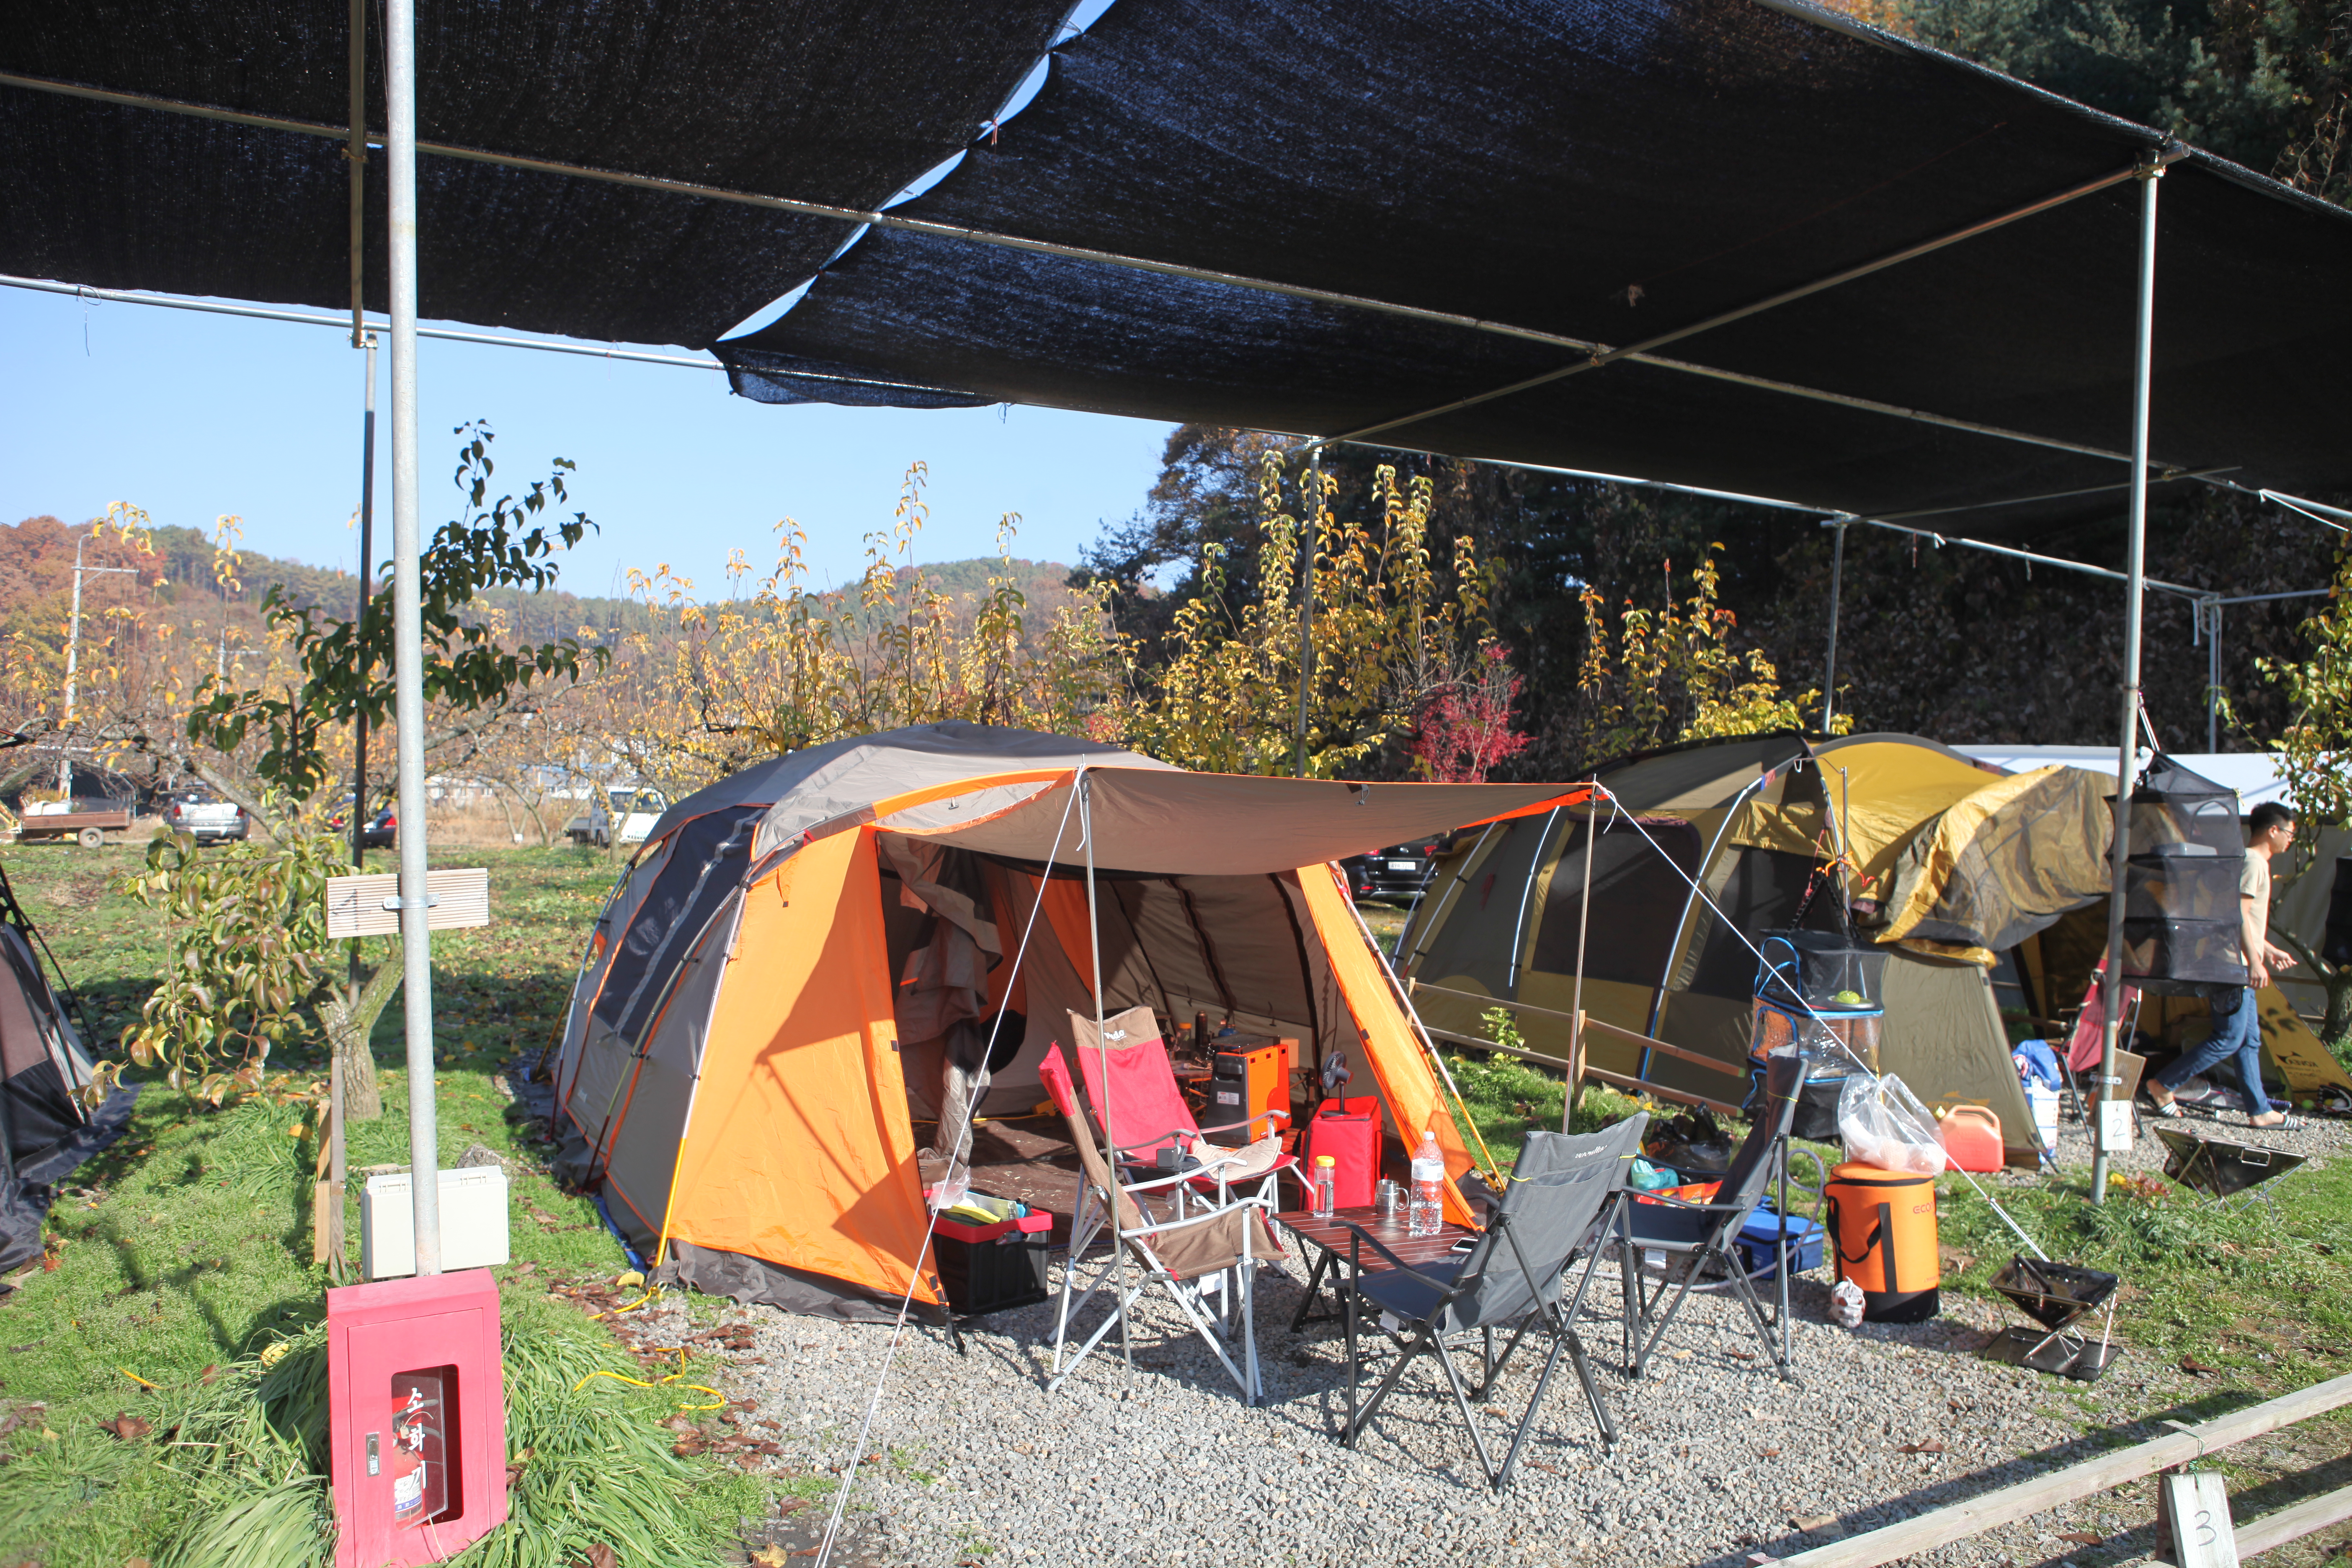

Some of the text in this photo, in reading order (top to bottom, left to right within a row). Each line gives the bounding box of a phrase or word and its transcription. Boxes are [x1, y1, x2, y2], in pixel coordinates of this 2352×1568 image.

[332, 889, 371, 931] 4
[2112, 1118, 2125, 1137] 2
[407, 1386, 427, 1489] 소화기
[2194, 1510, 2217, 1546] 3
